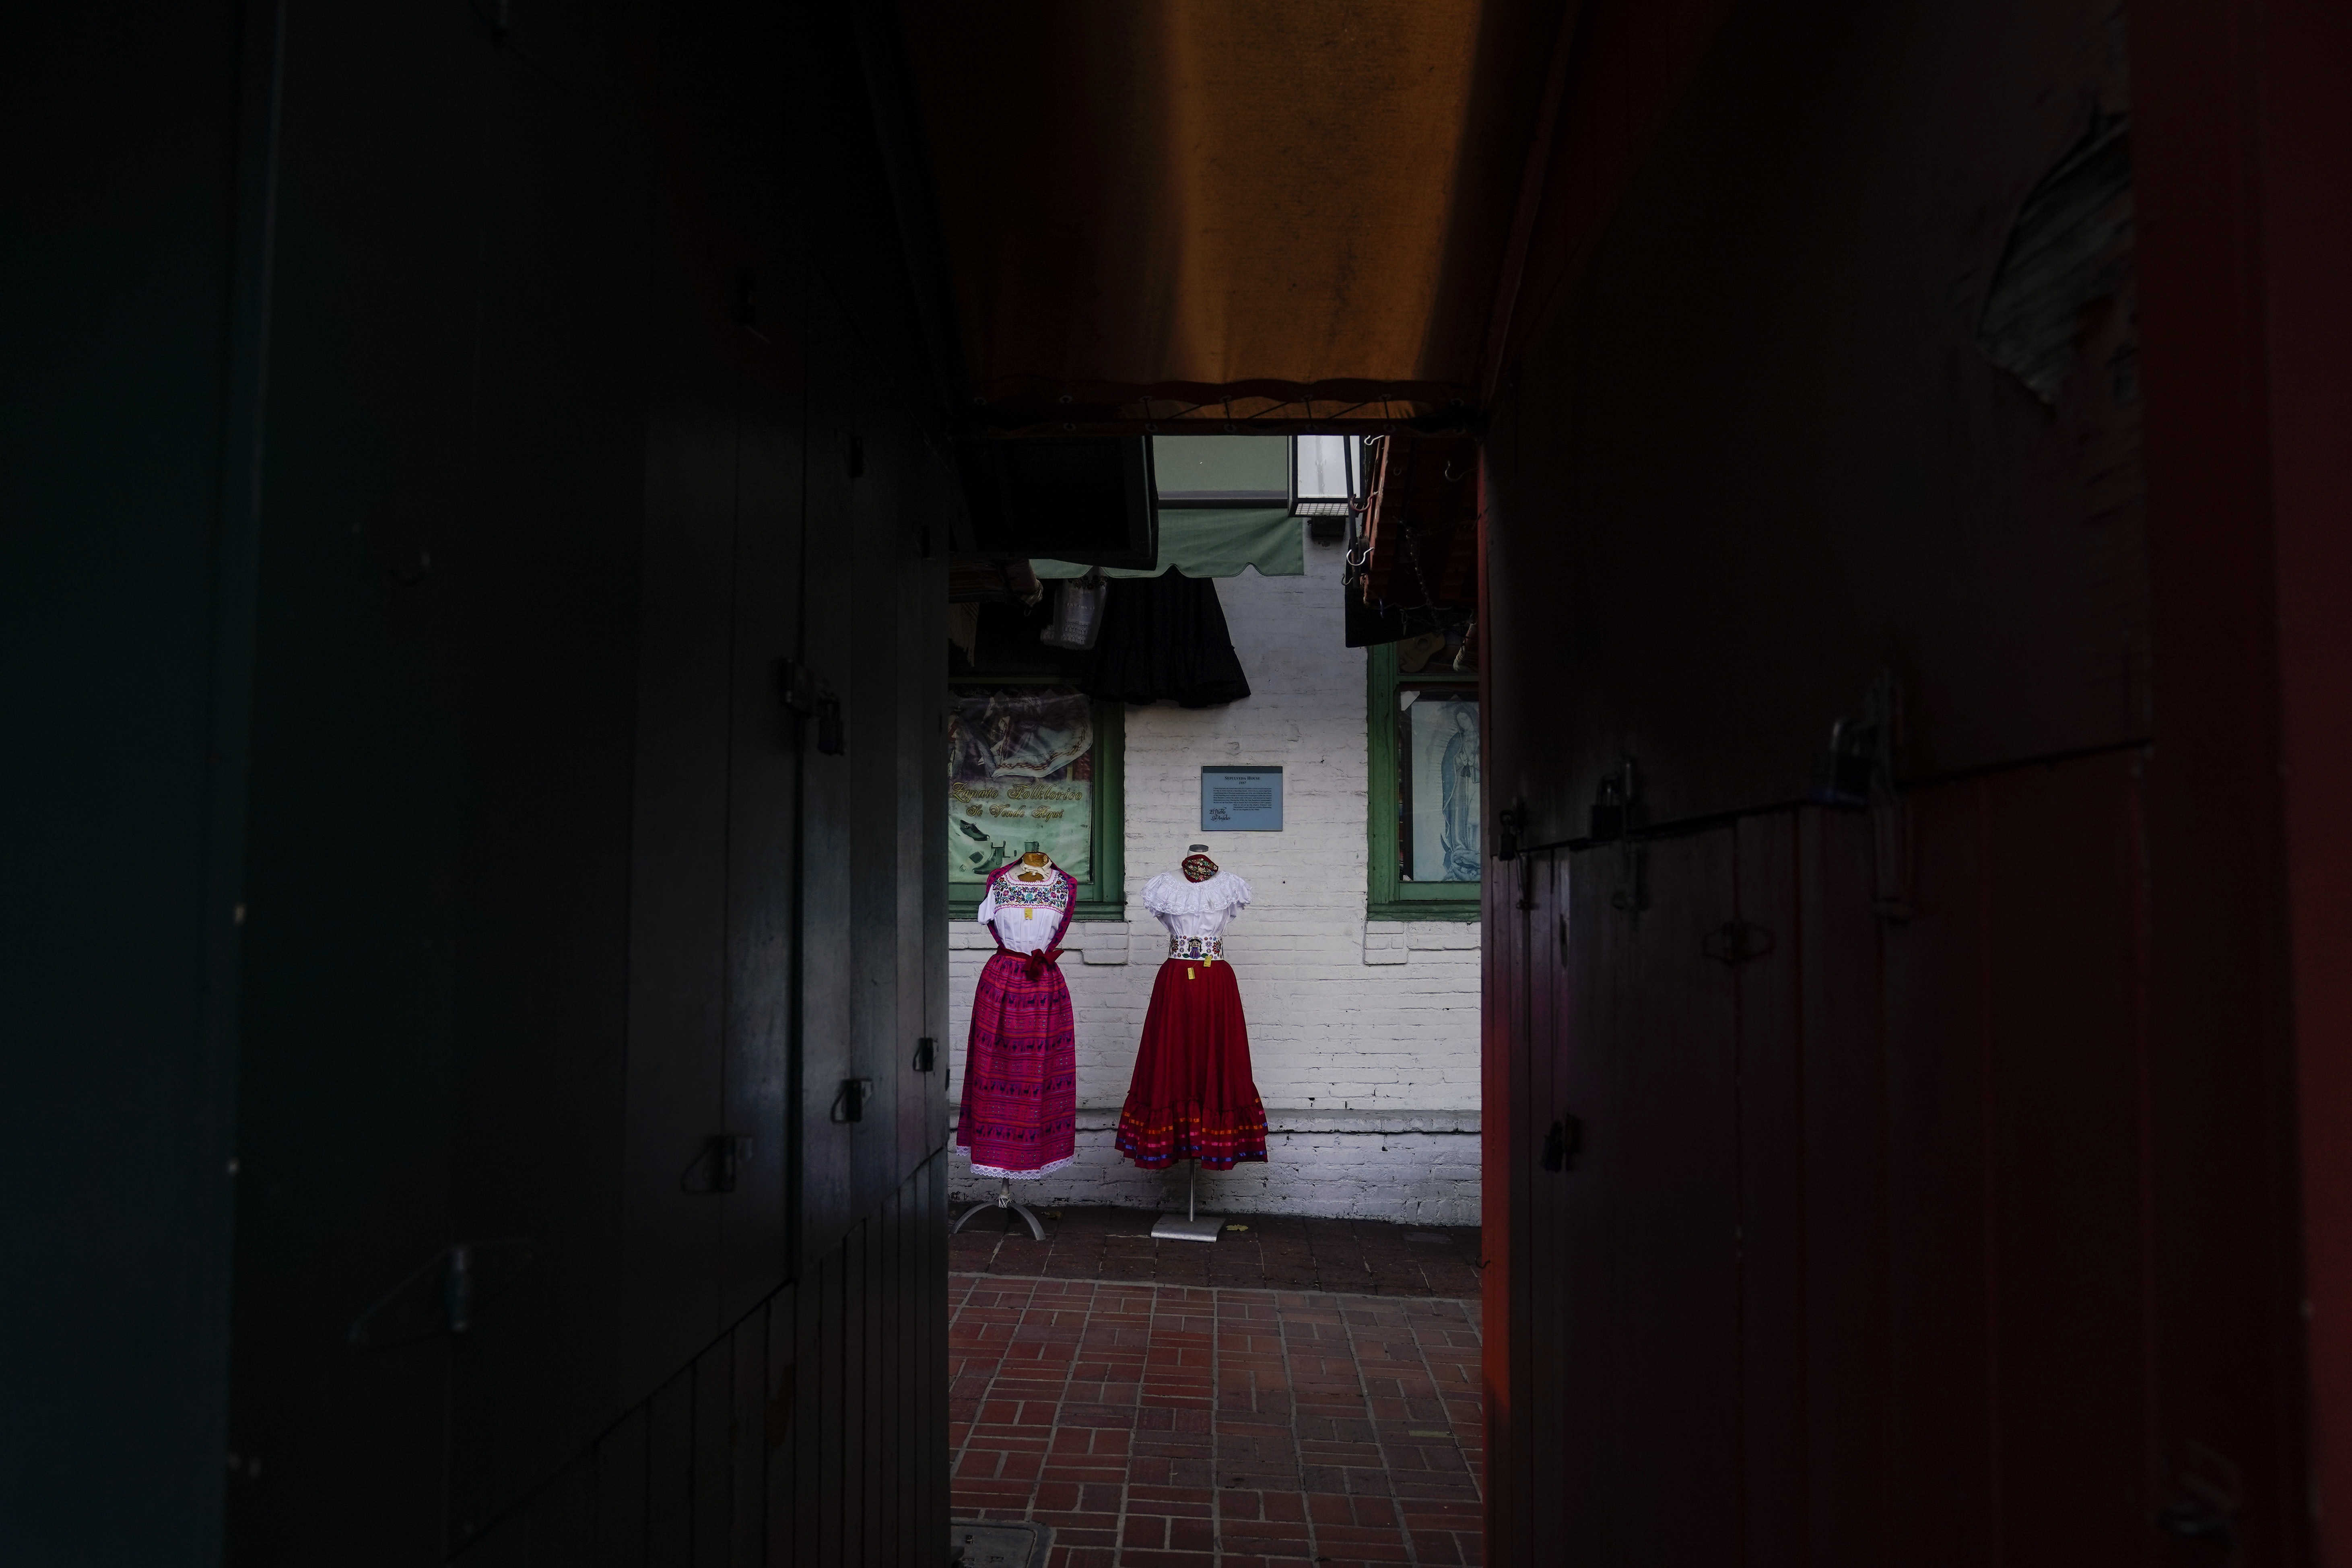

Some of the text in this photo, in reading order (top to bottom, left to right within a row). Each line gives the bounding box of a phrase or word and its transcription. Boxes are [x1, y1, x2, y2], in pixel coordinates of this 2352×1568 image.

[949, 782, 1082, 803] Zapato Folklorico
[966, 804, 1064, 822] Se Vende Aqui
